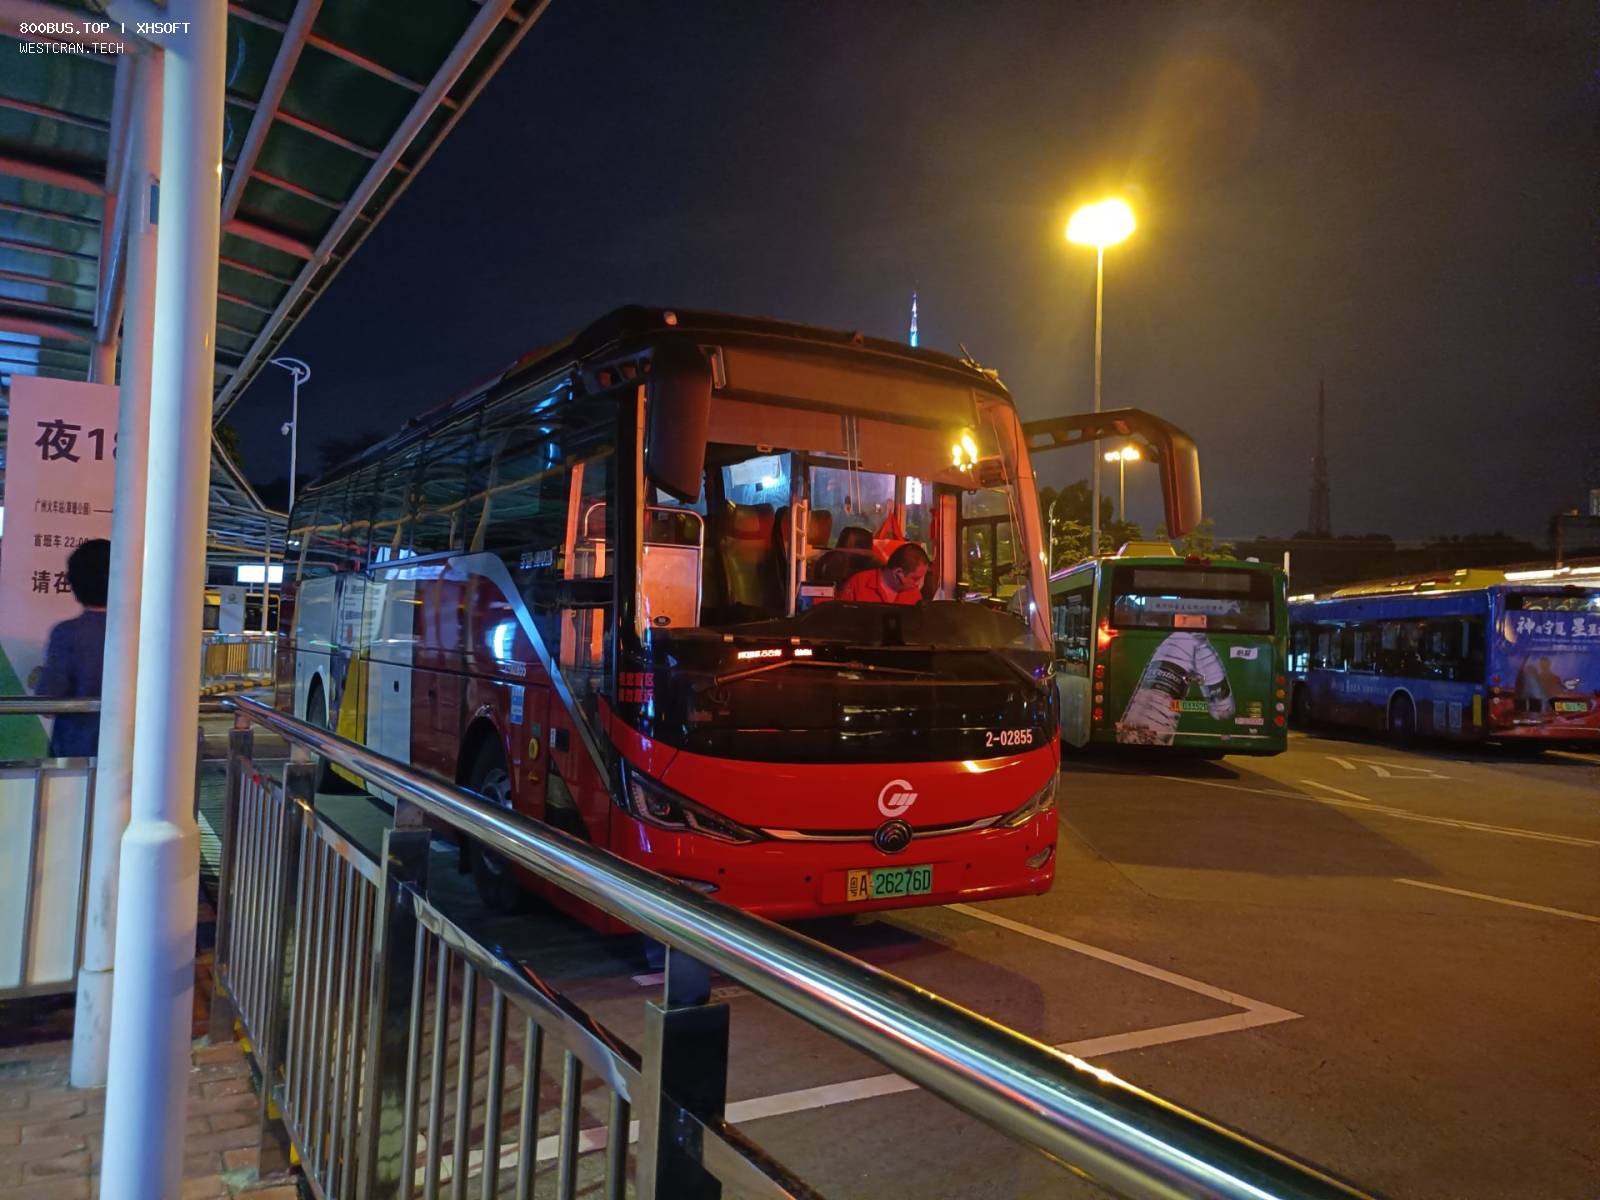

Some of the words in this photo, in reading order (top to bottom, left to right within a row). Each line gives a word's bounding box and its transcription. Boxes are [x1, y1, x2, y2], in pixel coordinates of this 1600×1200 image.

[35, 419, 118, 463] 夜1
[986, 728, 1033, 747] 2-02855
[876, 869, 931, 895] 26276D
